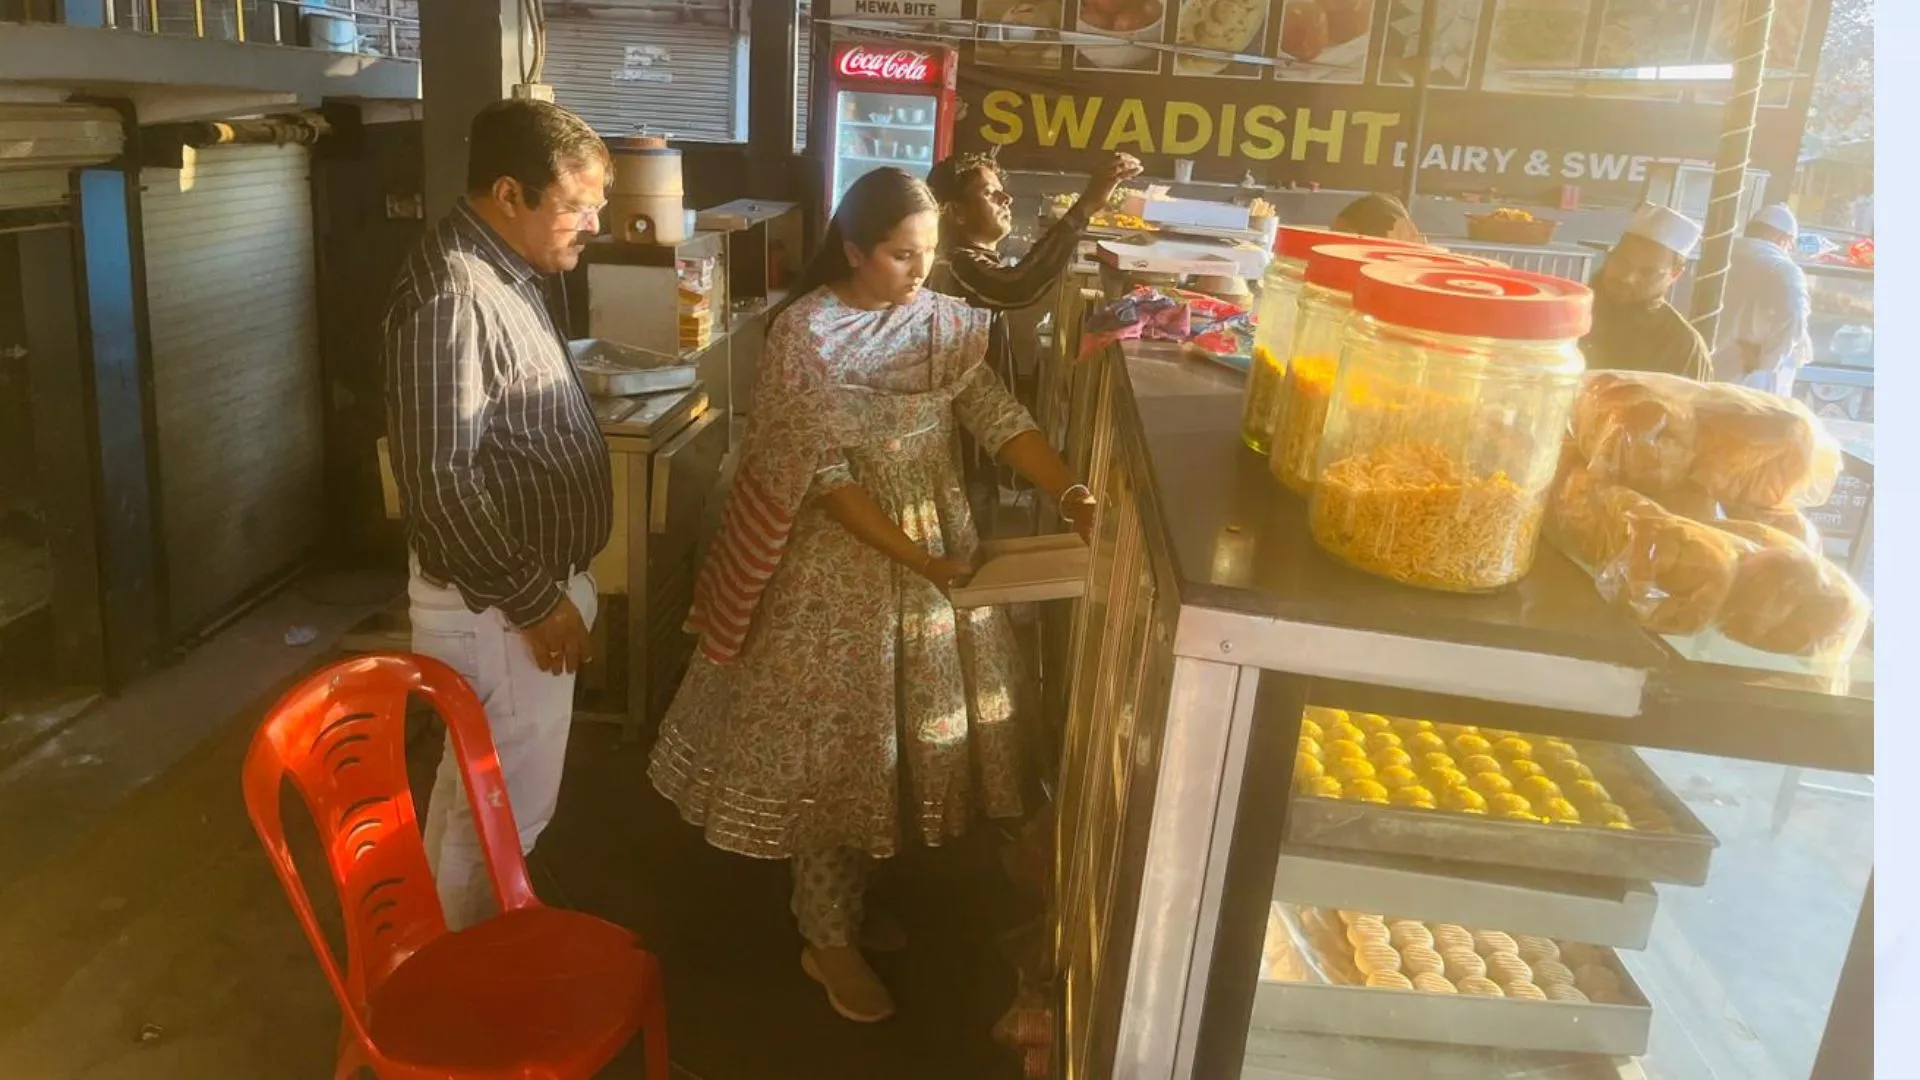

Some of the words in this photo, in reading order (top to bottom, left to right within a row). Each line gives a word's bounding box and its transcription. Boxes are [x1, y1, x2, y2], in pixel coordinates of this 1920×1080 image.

[855, 1, 900, 15] MEWA
[903, 3, 937, 17] BITE
[979, 90, 1400, 165] SWADISHT
[1523, 149, 1551, 177] &
